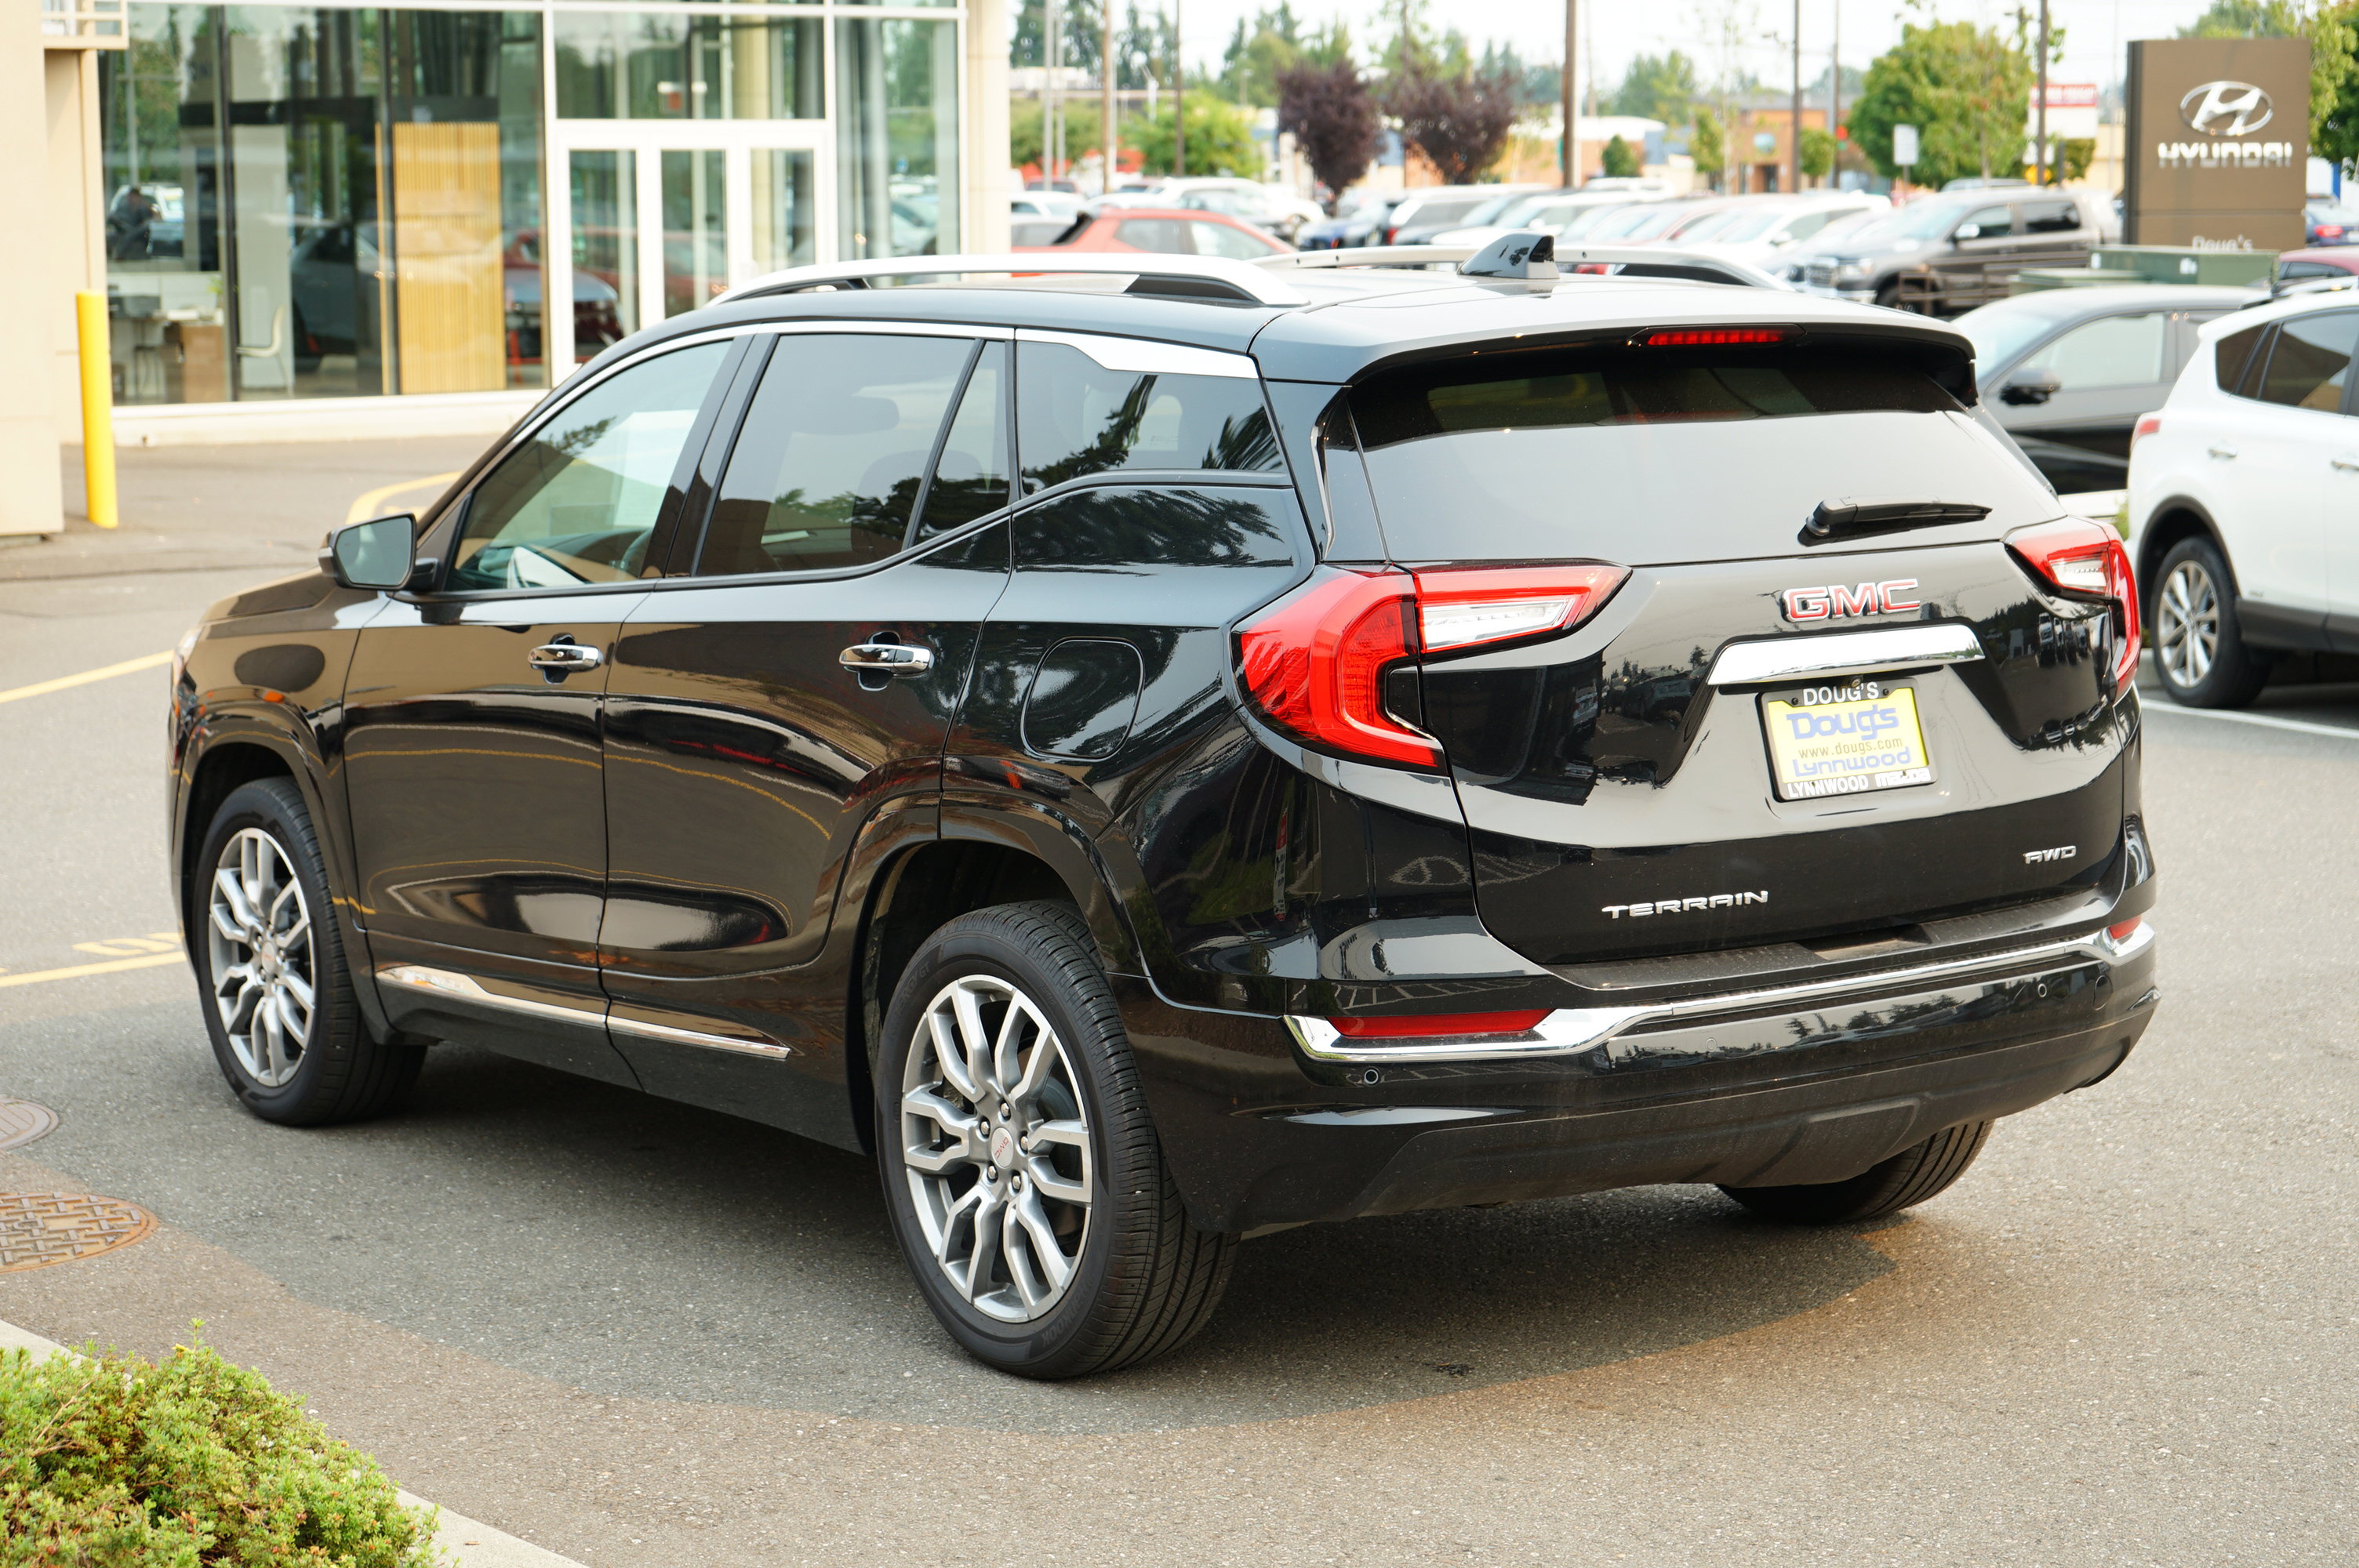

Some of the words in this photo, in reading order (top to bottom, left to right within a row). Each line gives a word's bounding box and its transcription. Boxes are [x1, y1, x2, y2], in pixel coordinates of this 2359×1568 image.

[2157, 142, 2293, 169] HYUNDAI
[1783, 579, 1920, 622] GMC
[1803, 682, 1878, 706] DOUG'S
[1798, 738, 1903, 759] www.dougs.com
[1792, 746, 1911, 777] Lynnwood
[1787, 775, 1869, 798] LYNNWOOD
[2024, 845, 2077, 864] AWD
[1601, 891, 1768, 919] TERRAIN
[994, 1137, 1009, 1160] GMC
